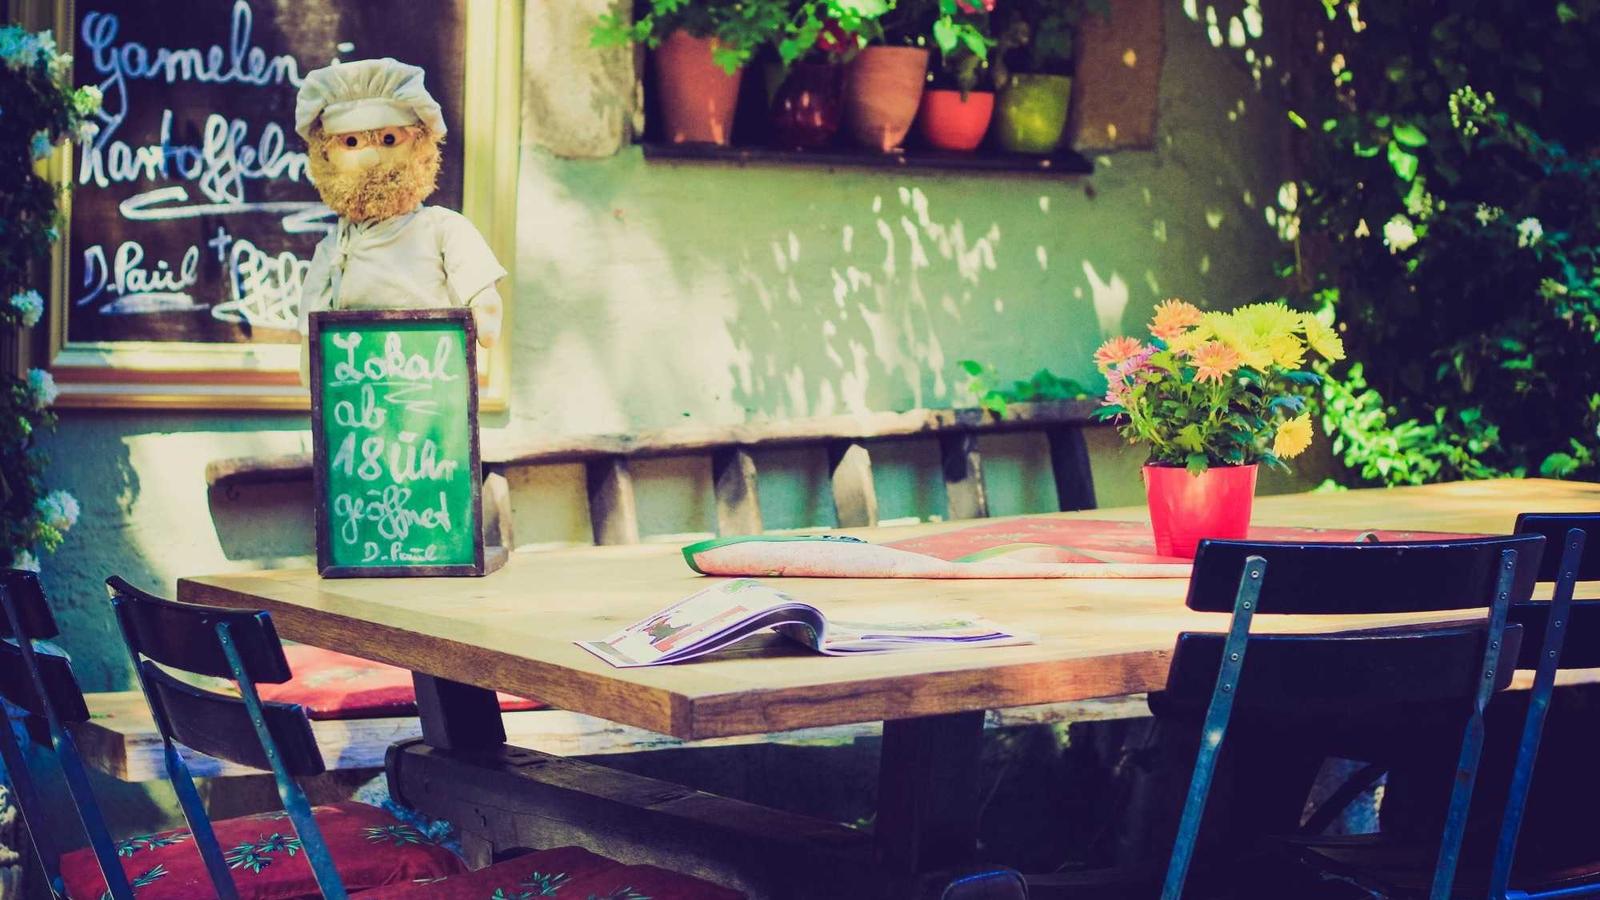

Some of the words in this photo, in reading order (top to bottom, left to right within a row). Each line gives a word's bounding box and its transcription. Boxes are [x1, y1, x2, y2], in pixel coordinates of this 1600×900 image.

[332, 331, 460, 382] Lokal
[334, 383, 387, 430] ab
[332, 431, 385, 482] 18
